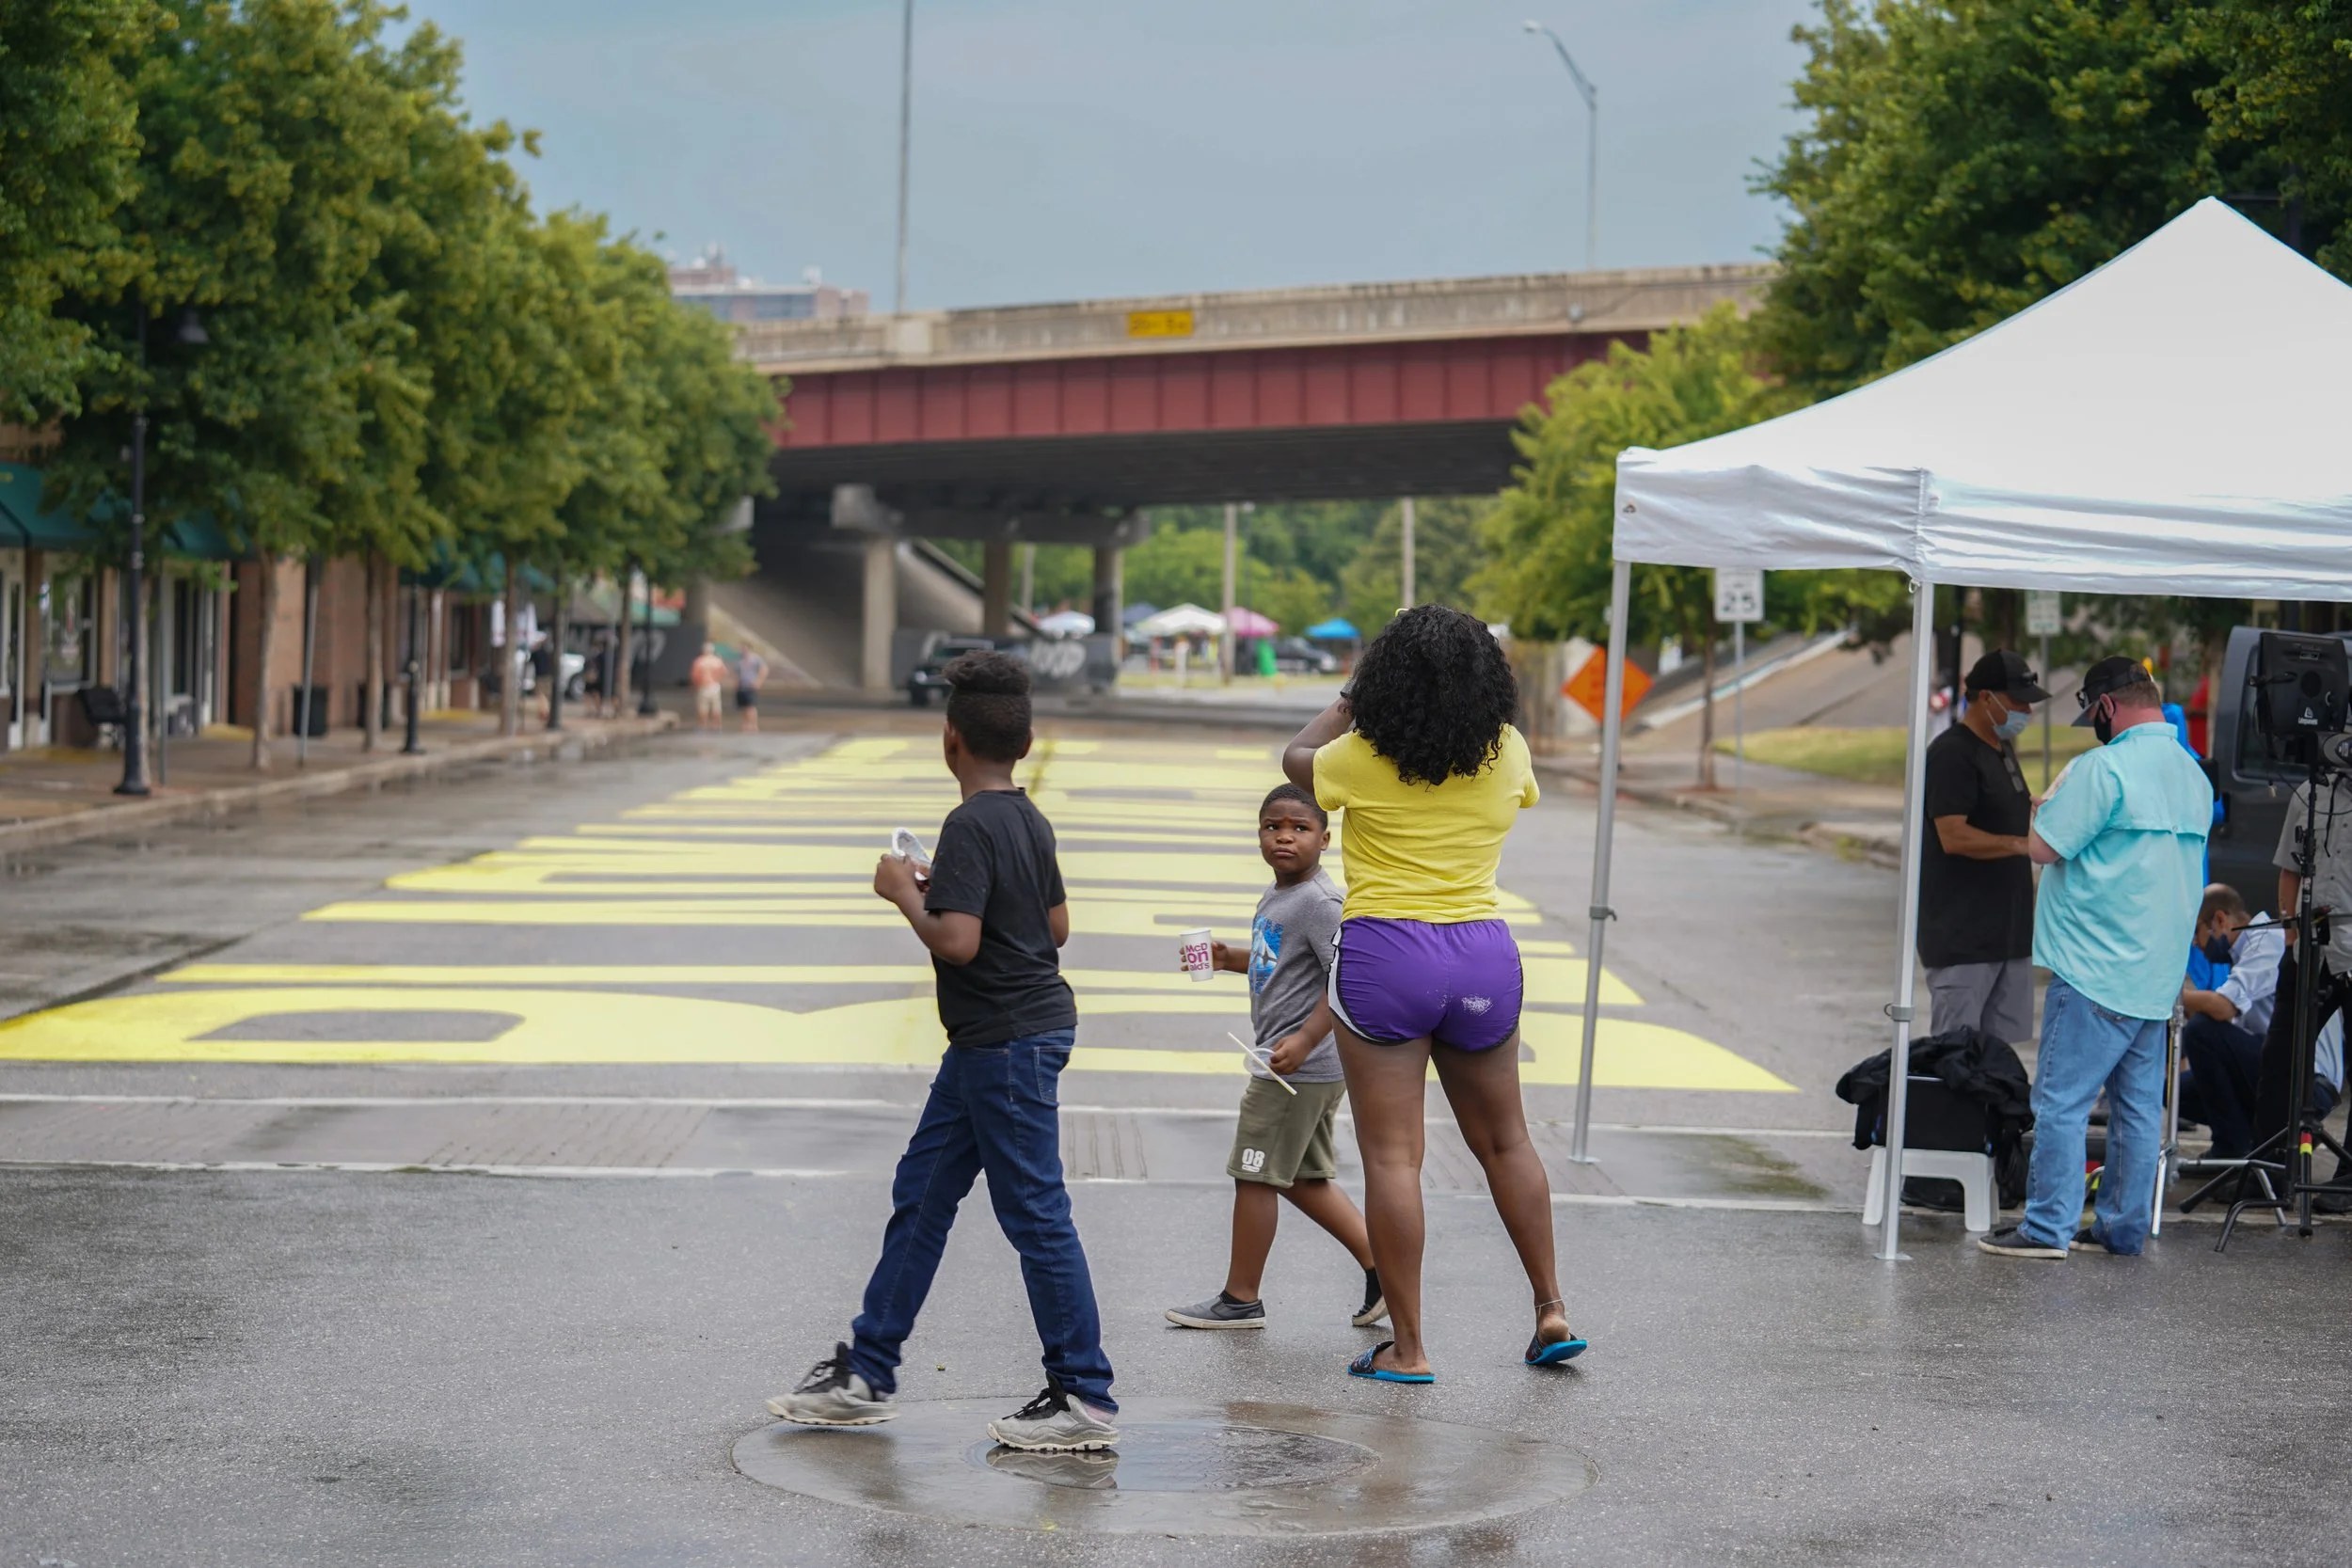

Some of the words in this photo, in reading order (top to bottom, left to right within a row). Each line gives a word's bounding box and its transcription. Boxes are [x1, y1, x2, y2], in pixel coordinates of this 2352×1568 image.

[1723, 592, 1756, 613] 25
[1185, 942, 1208, 953] McD
[1187, 951, 1209, 964] on
[1242, 1148, 1265, 1168] 08
